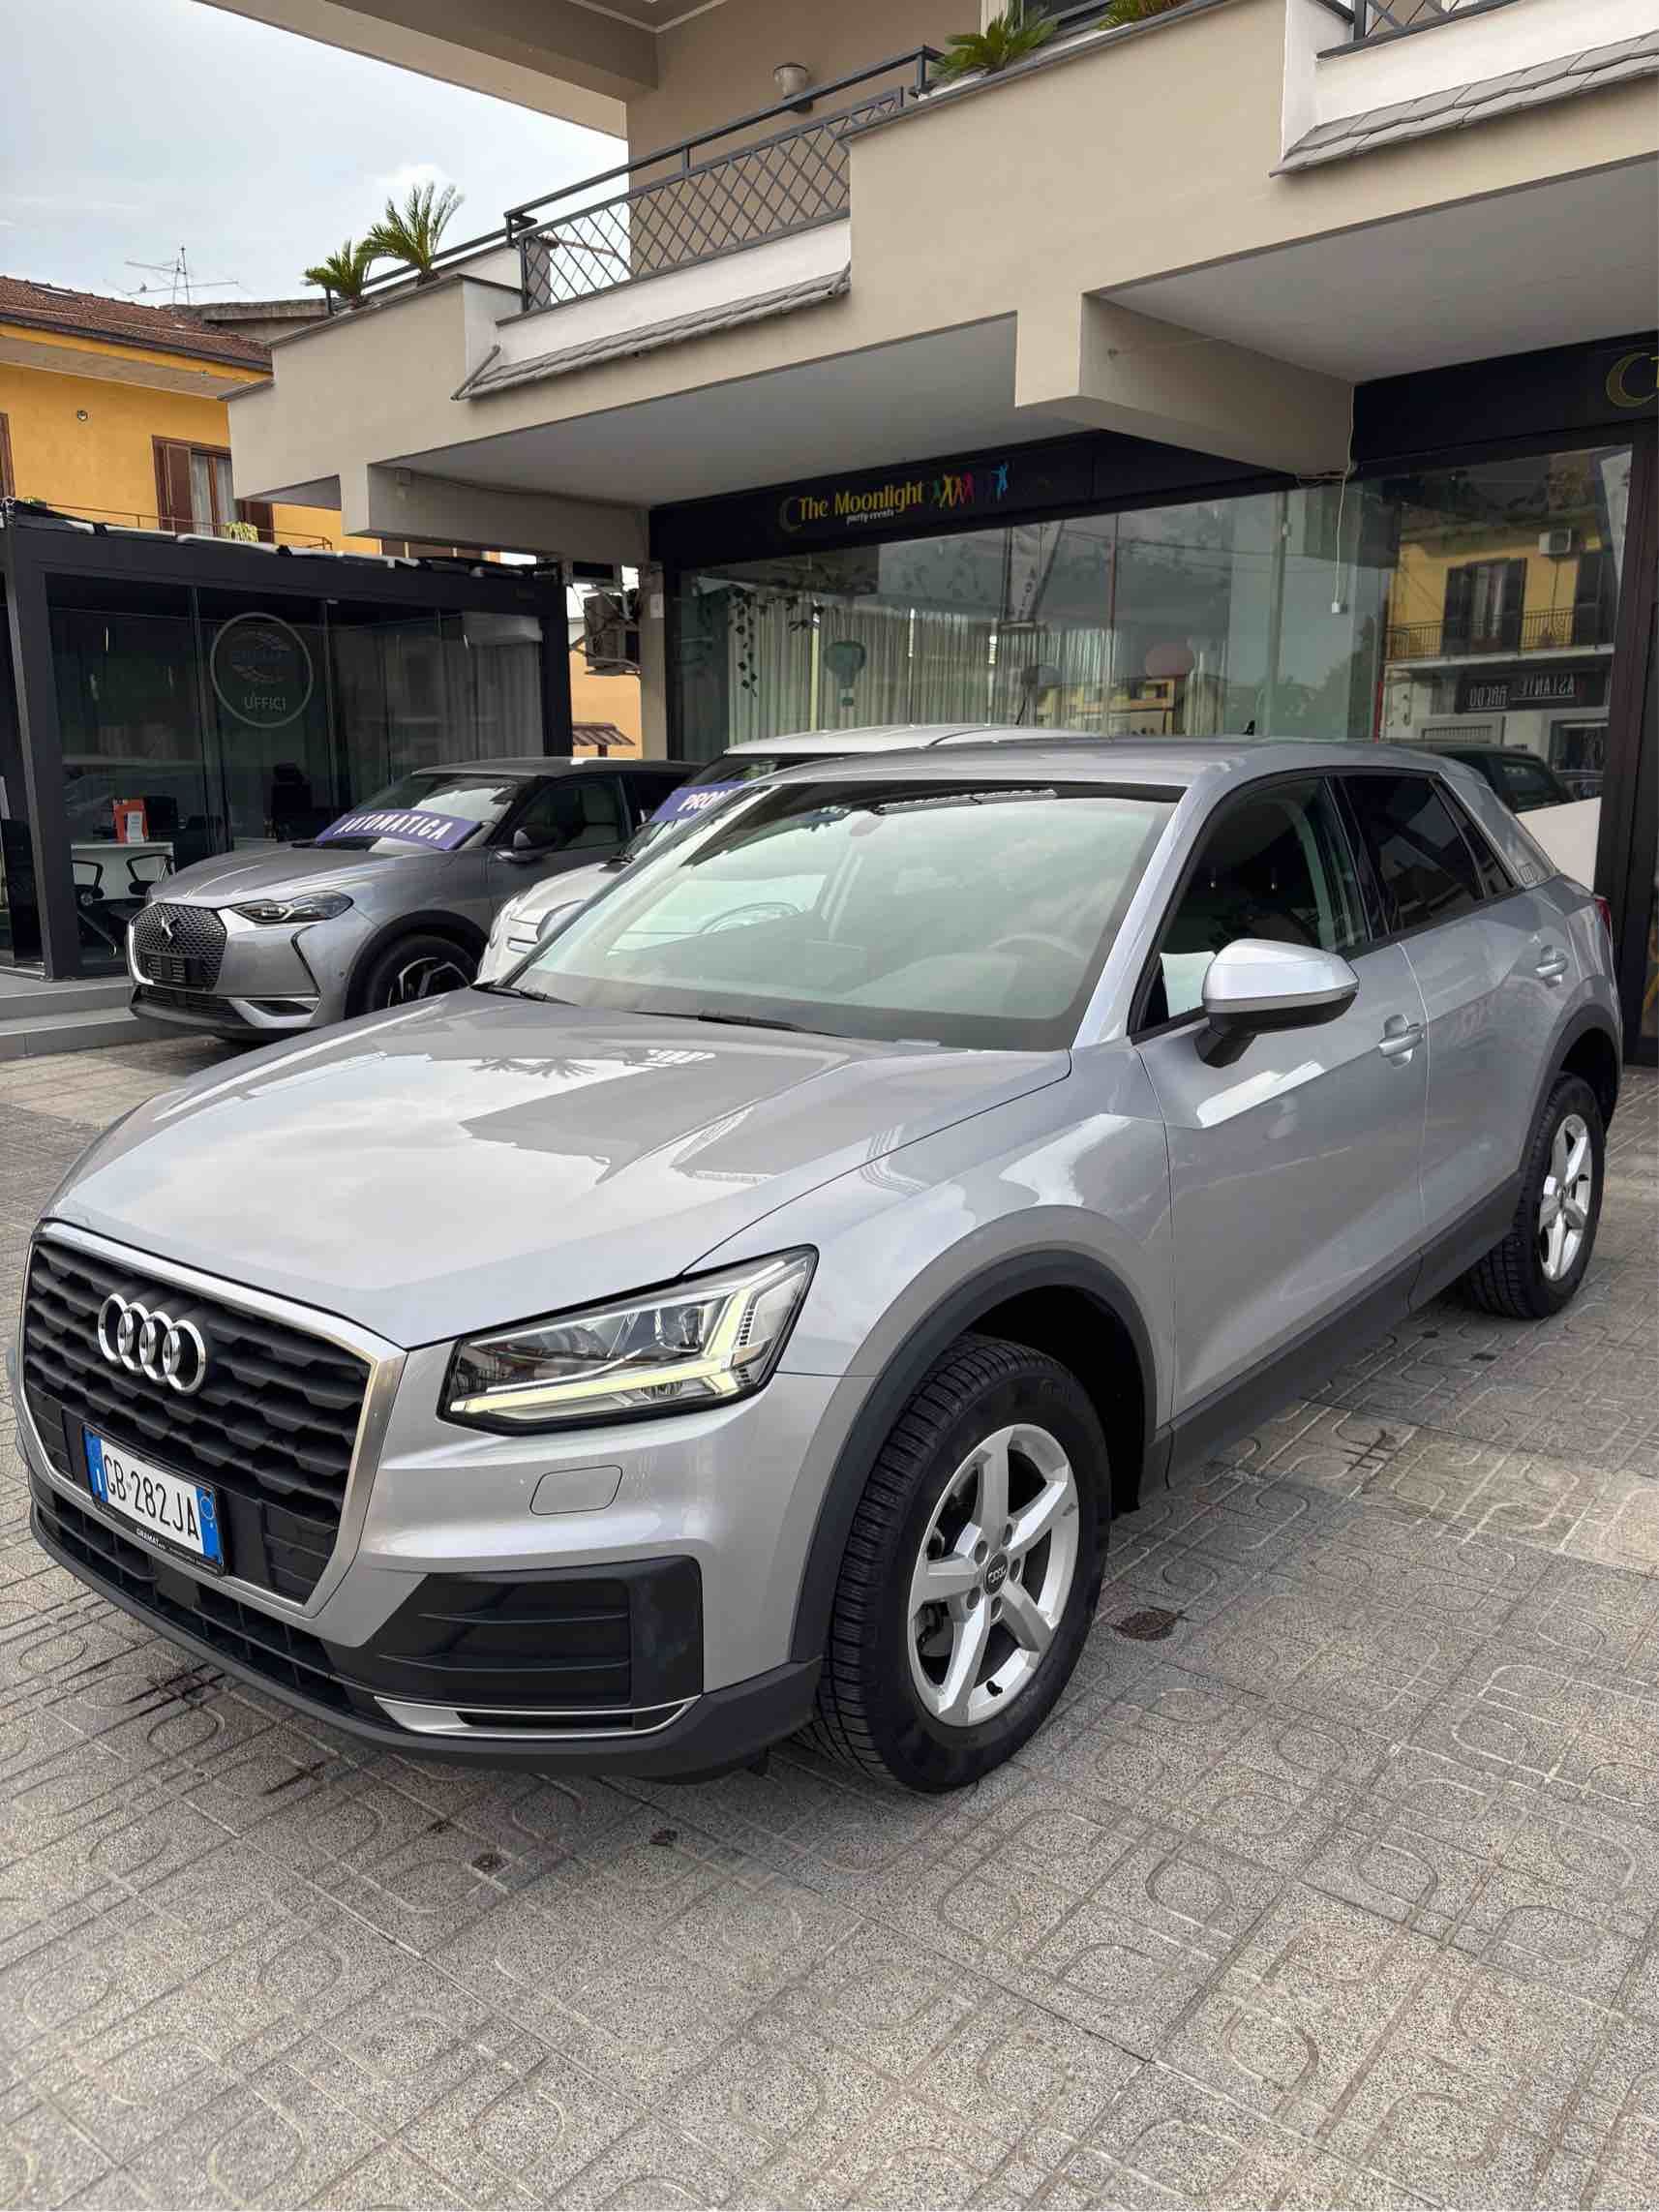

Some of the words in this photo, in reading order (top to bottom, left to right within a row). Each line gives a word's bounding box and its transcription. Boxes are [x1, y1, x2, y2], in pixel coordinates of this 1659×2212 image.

[798, 497, 829, 521] The
[834, 480, 924, 516] Moonlight
[846, 513, 868, 526] party
[244, 696, 286, 712] UFFICI
[333, 814, 453, 840] AUTOMATICA
